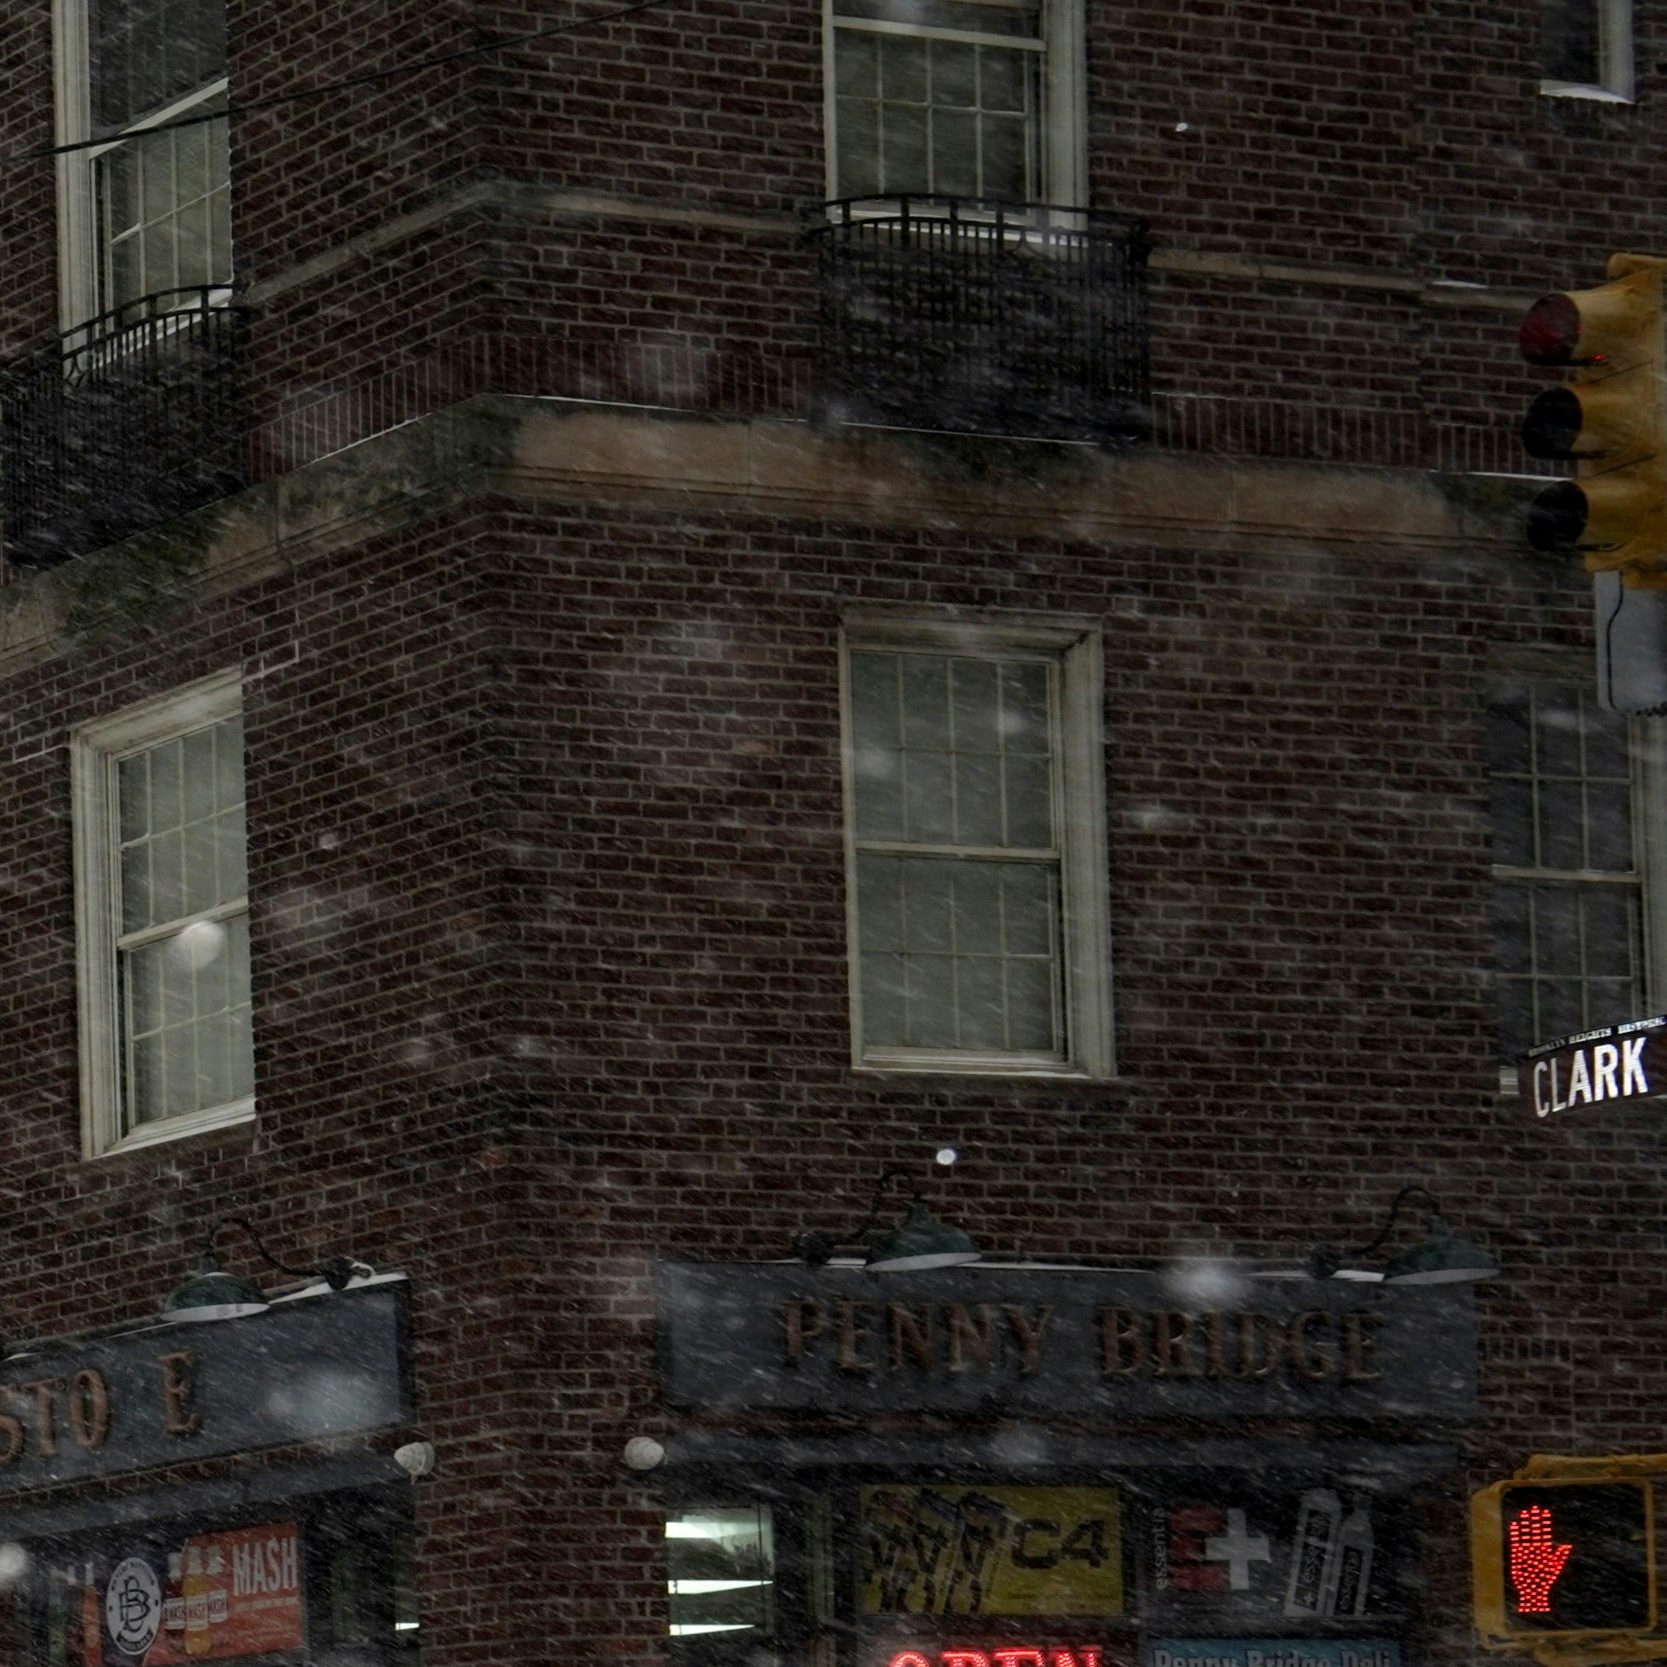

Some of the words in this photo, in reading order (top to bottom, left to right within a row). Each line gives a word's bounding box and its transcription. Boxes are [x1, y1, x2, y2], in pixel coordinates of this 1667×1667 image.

[1568, 1027, 1612, 1044] HEIGHTS
[1533, 1036, 1648, 1118] CLARK
[782, 1299, 1055, 1374] PENNY
[1097, 1304, 1386, 1379] BRIDGE
[1011, 1518, 1109, 1569] C4
